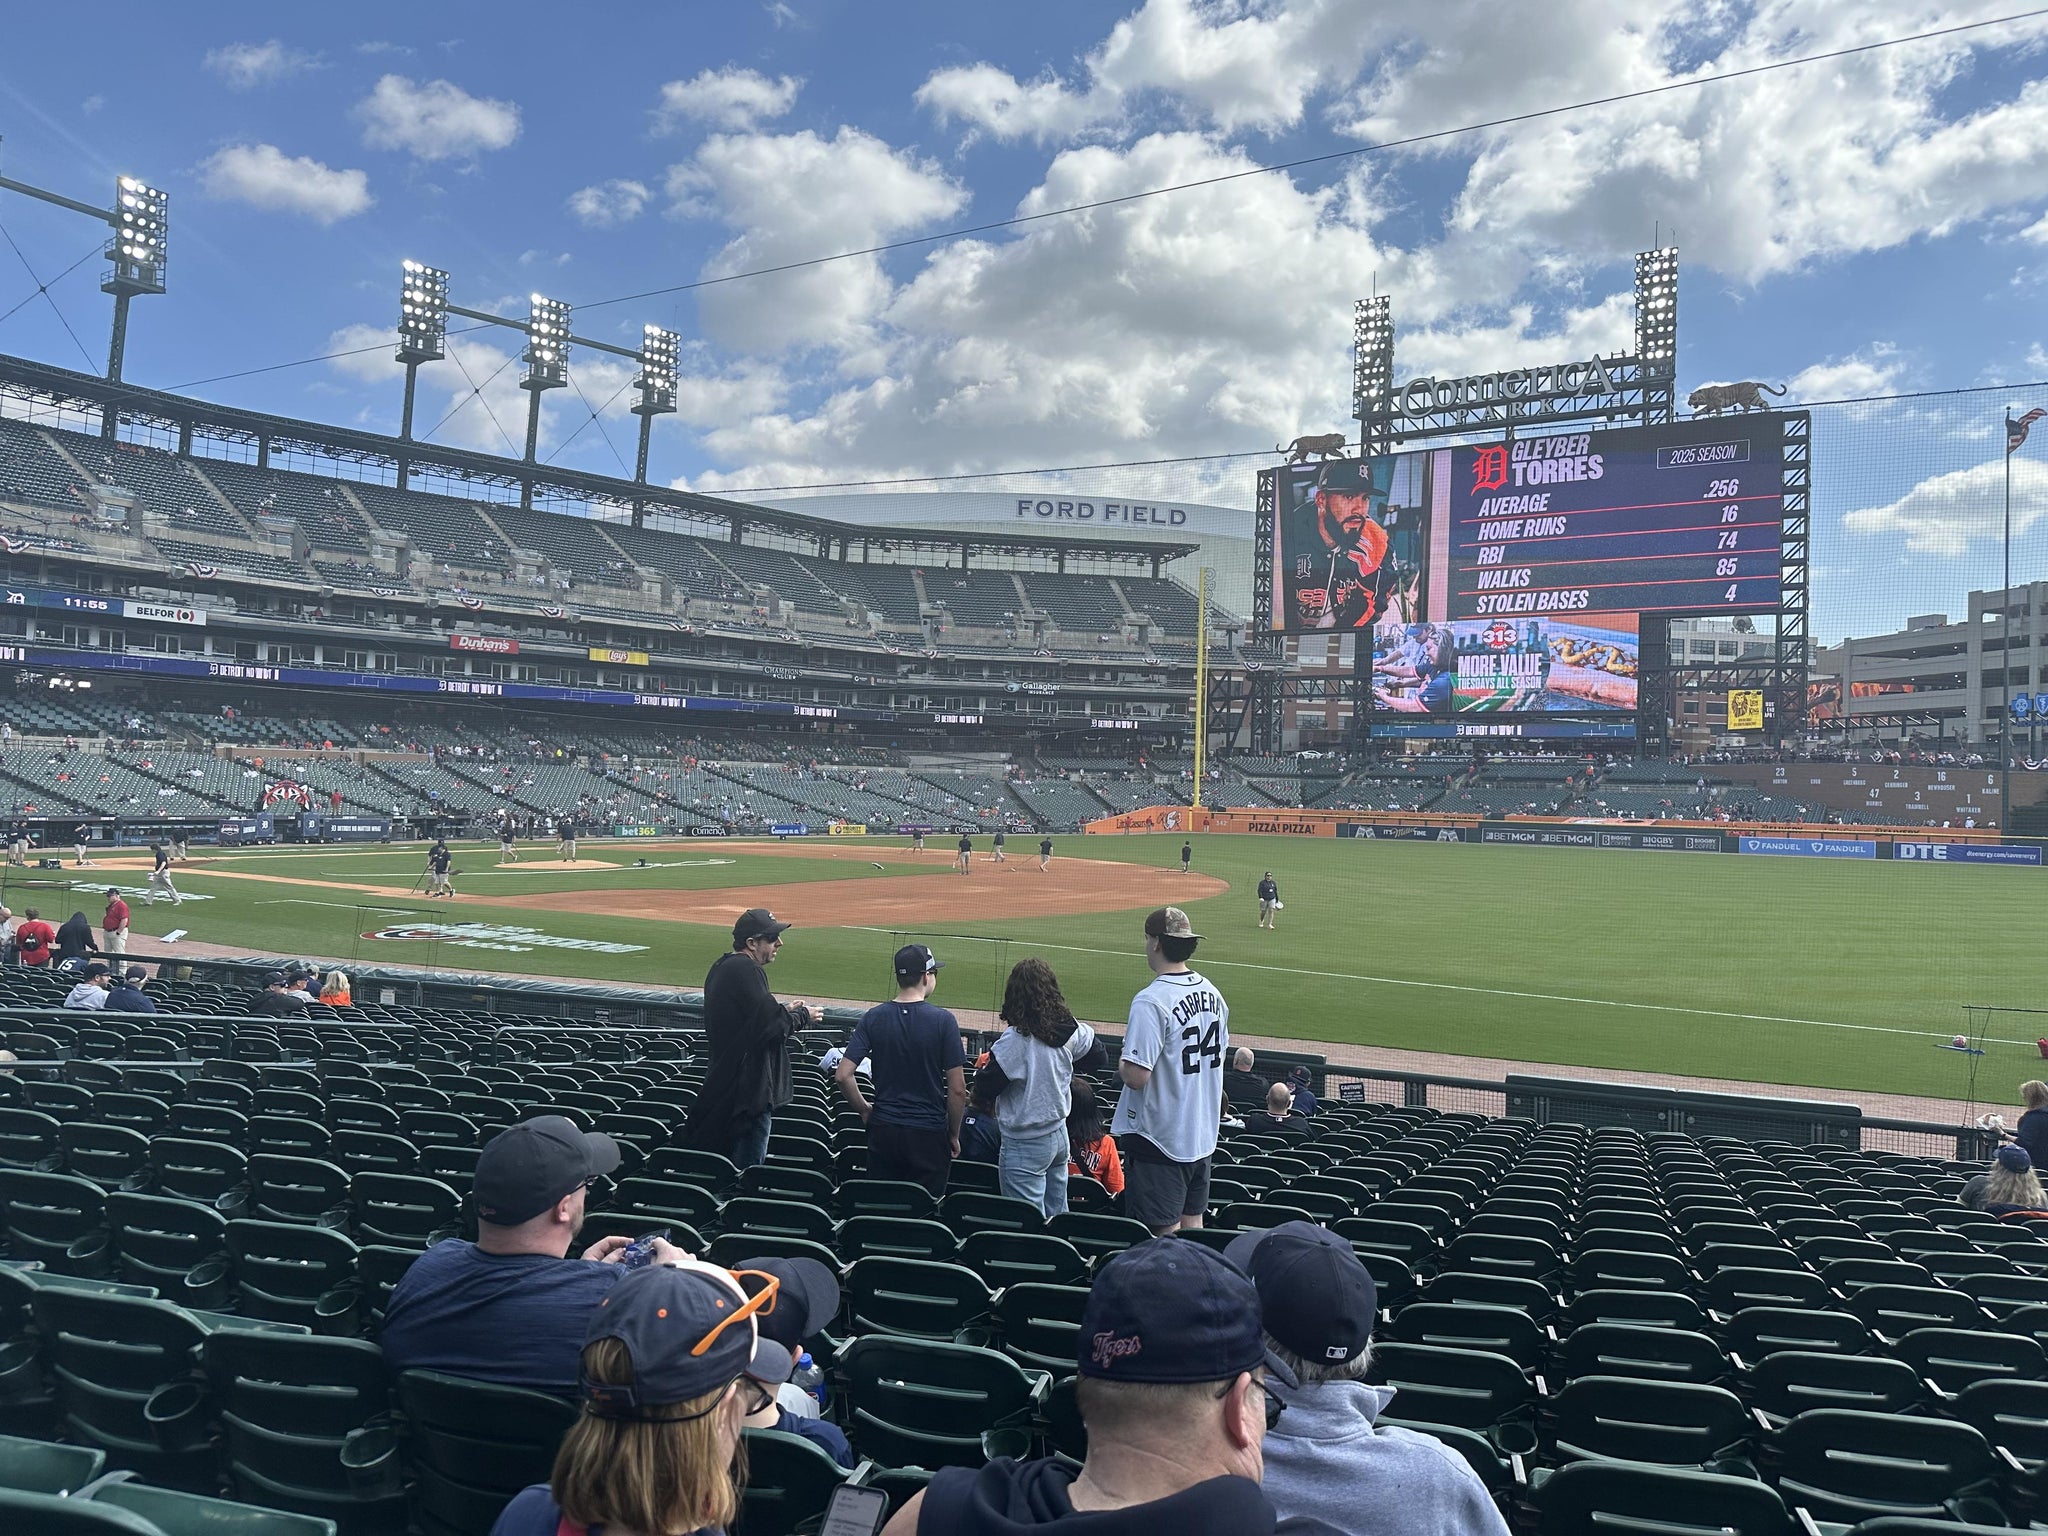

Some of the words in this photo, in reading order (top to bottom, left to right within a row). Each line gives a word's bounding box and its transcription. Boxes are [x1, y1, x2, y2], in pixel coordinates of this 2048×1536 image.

[1456, 398, 1556, 425] PARK
[1511, 434, 1591, 462] GLEYBER
[1670, 449, 1696, 465] 2025
[1697, 444, 1737, 462] SEASON
[1511, 454, 1604, 487] TORRES
[1703, 479, 1739, 498] .256
[1478, 493, 1551, 517] AVERAGE
[1018, 500, 1094, 519] FORD
[1105, 504, 1187, 525] FIELD
[1721, 504, 1738, 523] 16
[1478, 520, 1522, 540] HOME
[1523, 516, 1567, 537] RUNS
[1717, 531, 1738, 549] 74
[1477, 546, 1505, 565] RBI
[1716, 558, 1738, 576] 85
[1477, 569, 1531, 589] WALKS
[1725, 584, 1737, 602] 4
[63, 597, 108, 610] 11:55
[1476, 592, 1536, 613] STOLEN
[1537, 590, 1589, 611] BASES
[137, 607, 174, 618] BELFOR
[459, 636, 510, 650] Dunham's
[1483, 630, 1517, 643] 313
[764, 666, 803, 676] CHAMPIONS
[1457, 655, 1497, 677] MORE
[1500, 653, 1542, 676] VALUE
[777, 672, 793, 680] CLUB
[1457, 677, 1495, 690] TUESDAYS
[1496, 677, 1509, 689] ALL
[1511, 676, 1542, 689] SEASON
[1022, 682, 1061, 692] Gallagher
[1775, 767, 1785, 776] 23
[1893, 770, 1899, 779] 2
[1937, 771, 1946, 782] 16
[1987, 775, 1993, 785] 6
[1869, 789, 1880, 798] 47
[1914, 791, 1920, 801] 3
[1966, 794, 1971, 804] 1
[622, 827, 655, 836] bet365
[1249, 823, 1280, 833] PIZZA!
[1283, 824, 1315, 834] PIZZA!
[1494, 832, 1535, 841] BETMGM
[1549, 834, 1592, 844] BETMGM
[1642, 836, 1674, 844] BIGGBY
[1762, 842, 1801, 851] FANDUEL
[1825, 844, 1866, 853] FANDUEL
[1900, 844, 1947, 860] DTE
[1966, 850, 2037, 860] dteenergy.com/saveenergy
[1172, 991, 1222, 1026] CABRERA
[1181, 1020, 1221, 1075] 24
[1092, 1330, 1142, 1369] Tigers
